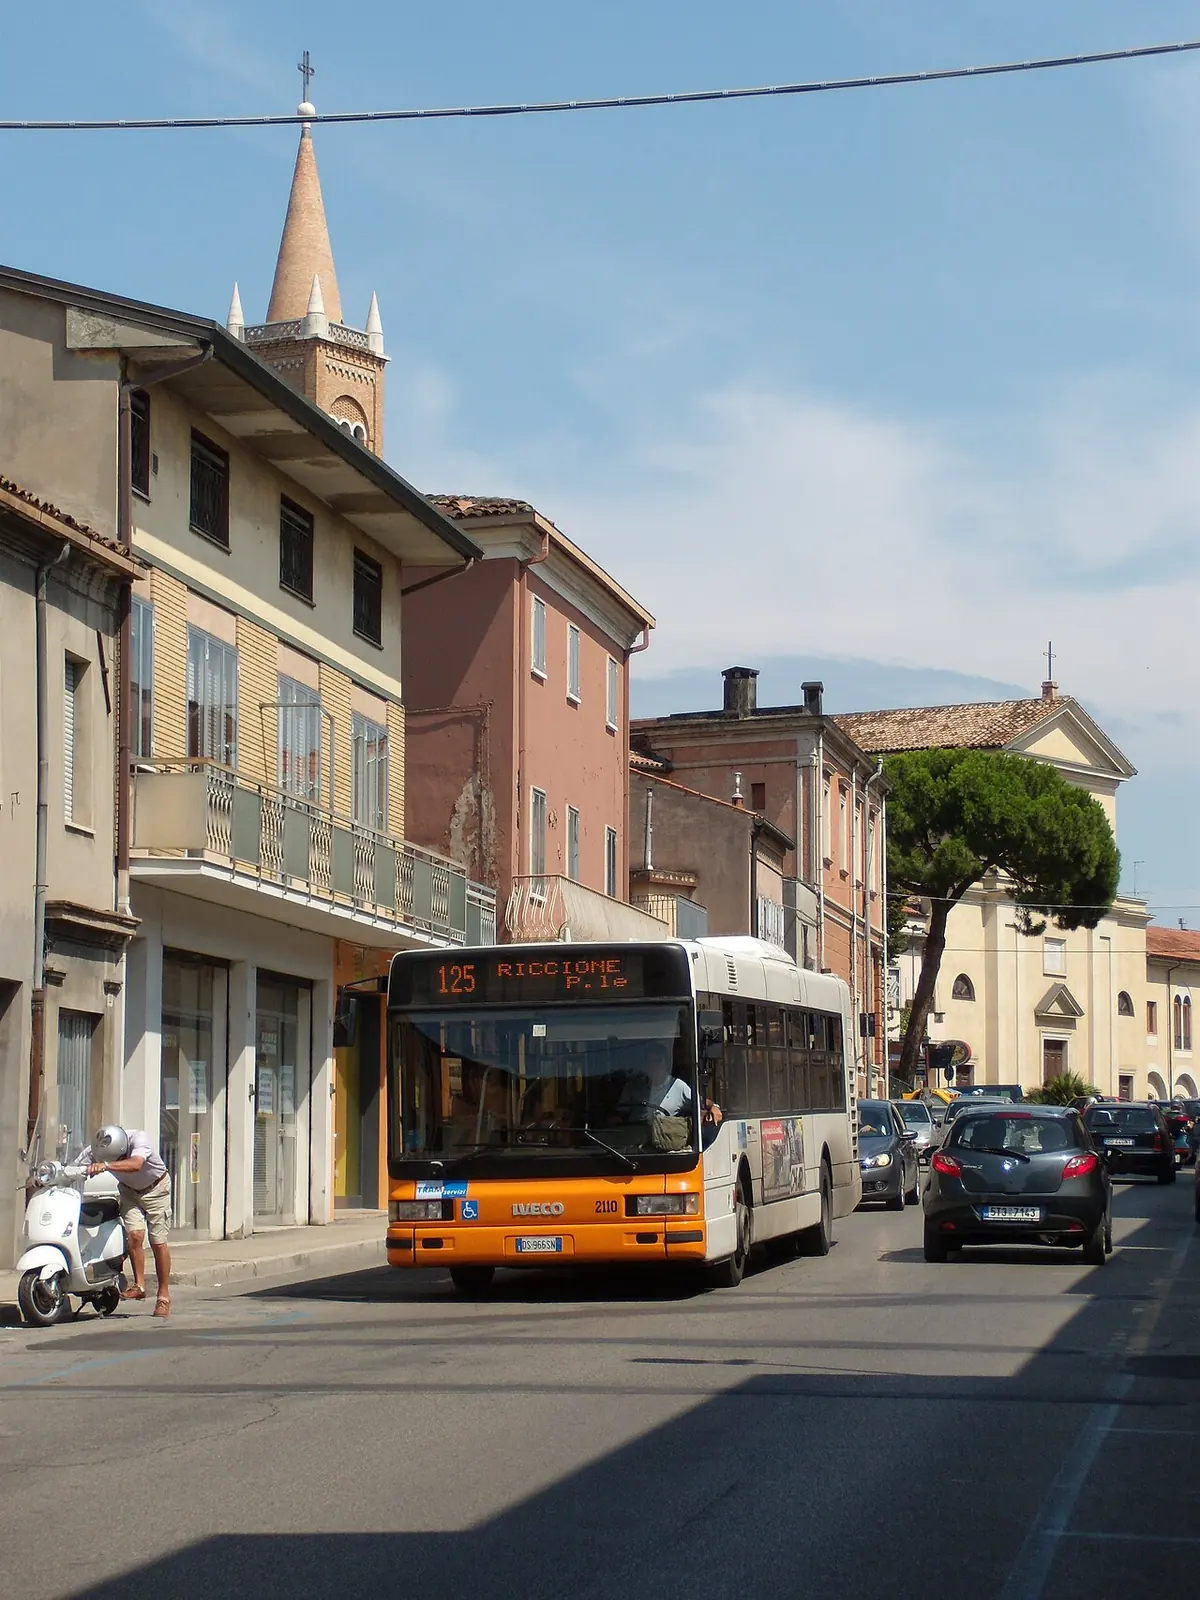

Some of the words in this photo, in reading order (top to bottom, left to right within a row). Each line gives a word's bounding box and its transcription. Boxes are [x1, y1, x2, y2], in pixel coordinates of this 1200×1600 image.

[498, 960, 621, 977] RICCIONE
[438, 965, 476, 993] 125
[512, 1202, 564, 1216] IVECO
[595, 1200, 618, 1213] 2110
[1013, 1207, 1036, 1218] 7143
